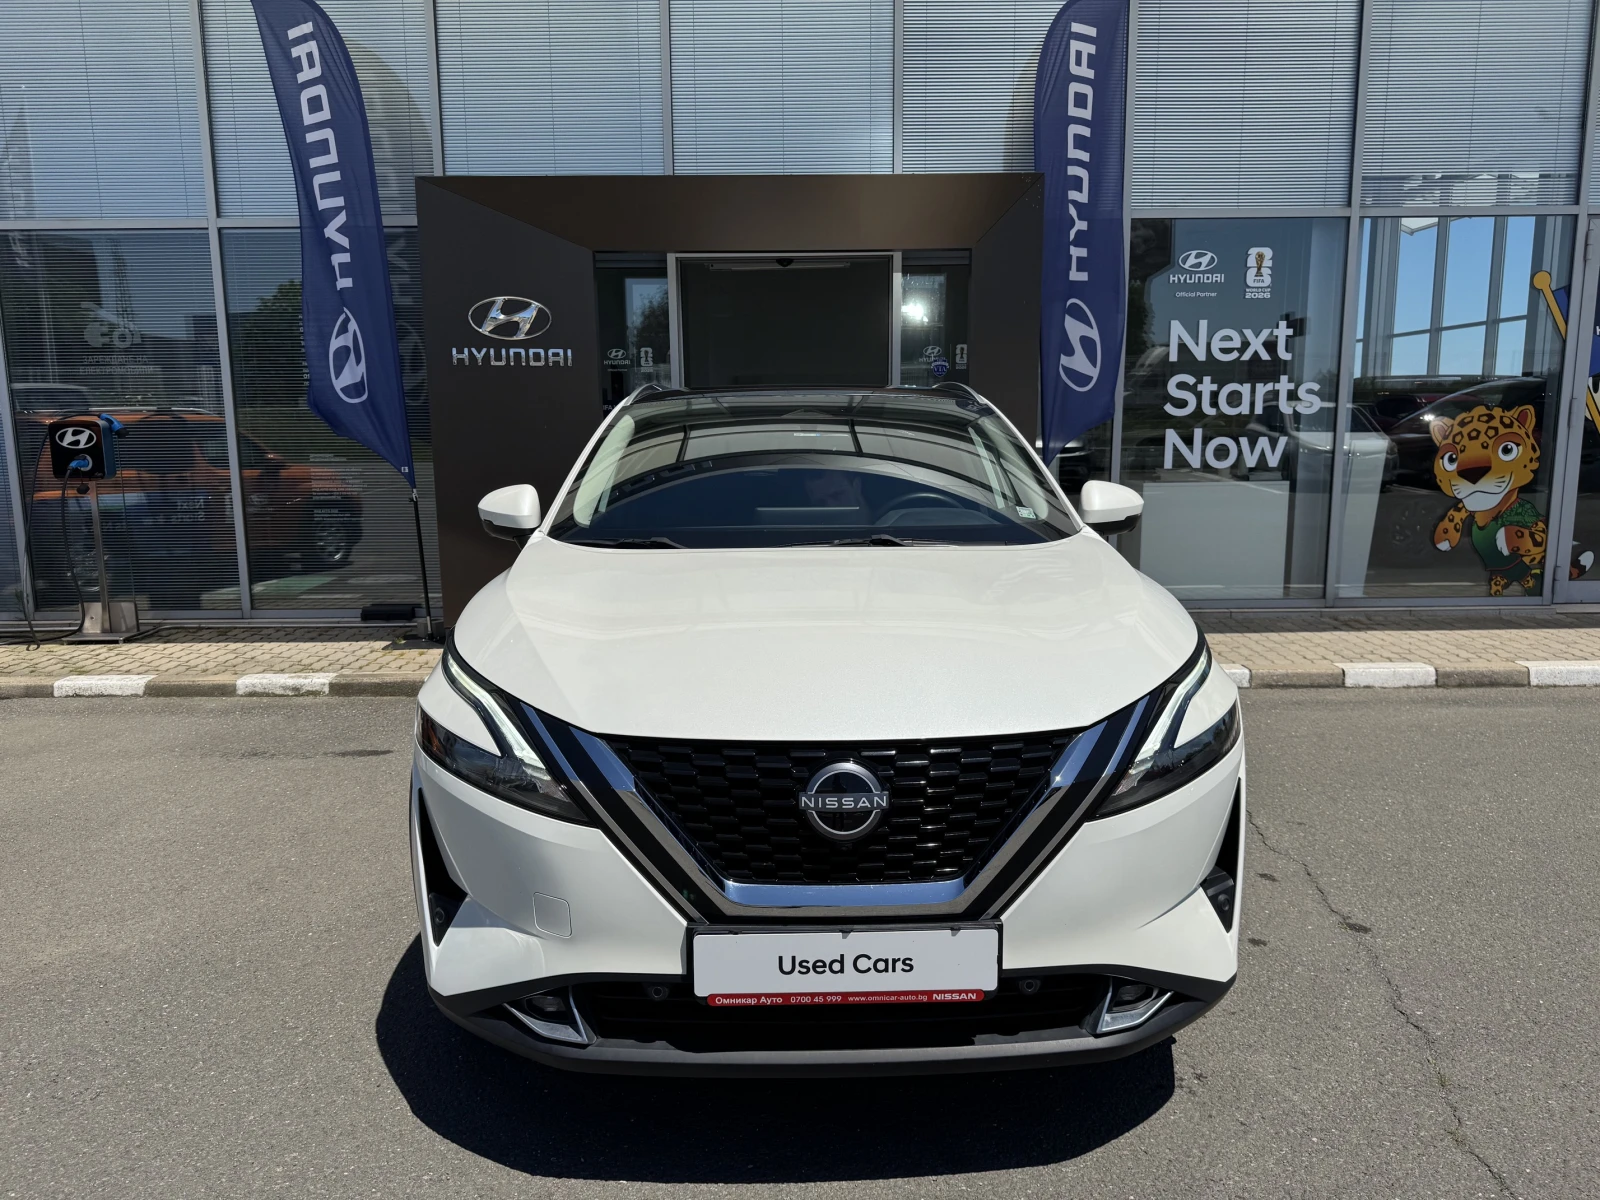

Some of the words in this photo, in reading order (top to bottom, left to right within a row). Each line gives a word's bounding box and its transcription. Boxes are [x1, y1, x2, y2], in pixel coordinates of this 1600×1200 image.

[1067, 22, 1097, 281] HYUNDAI
[1169, 274, 1224, 283] HYUNDAI
[1169, 320, 1293, 362] Next
[452, 347, 573, 367] HYUNDAI
[1163, 374, 1321, 416] Starts
[1164, 428, 1288, 469] Now
[801, 796, 887, 808] NISSAN
[778, 954, 845, 975] Used
[852, 953, 914, 974] Cars
[715, 997, 757, 1005] Омникар
[760, 996, 783, 1005] Ауто
